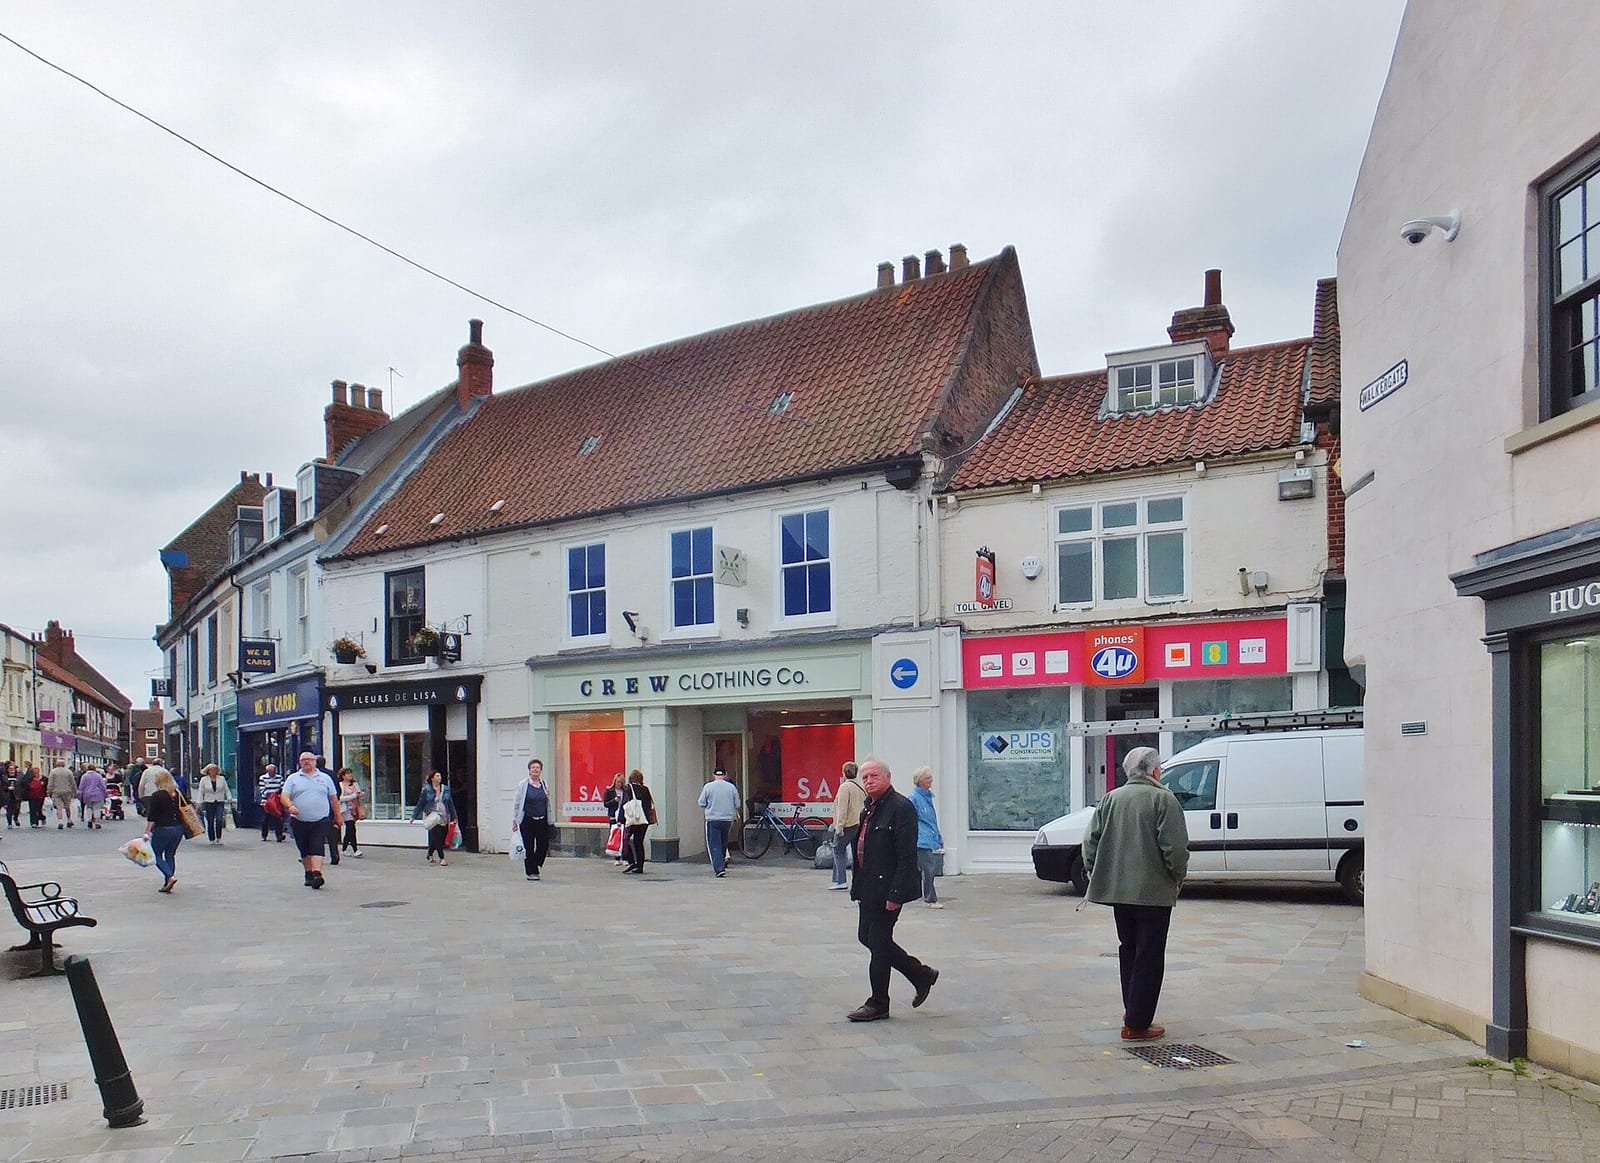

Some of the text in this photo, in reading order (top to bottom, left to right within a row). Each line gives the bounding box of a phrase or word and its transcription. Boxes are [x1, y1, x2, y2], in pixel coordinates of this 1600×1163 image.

[1362, 365, 1405, 406] WALKERGATE
[956, 602, 977, 612] TOLL
[1094, 634, 1134, 648] phones
[246, 658, 271, 666] CARDS
[580, 666, 809, 697] CREW CLOTHING Co.
[274, 692, 297, 713] CARDS
[352, 690, 437, 704] FLEURS DE LISA
[1010, 732, 1051, 749] PJPS
[579, 784, 603, 802] SA
[797, 777, 833, 799] SA
